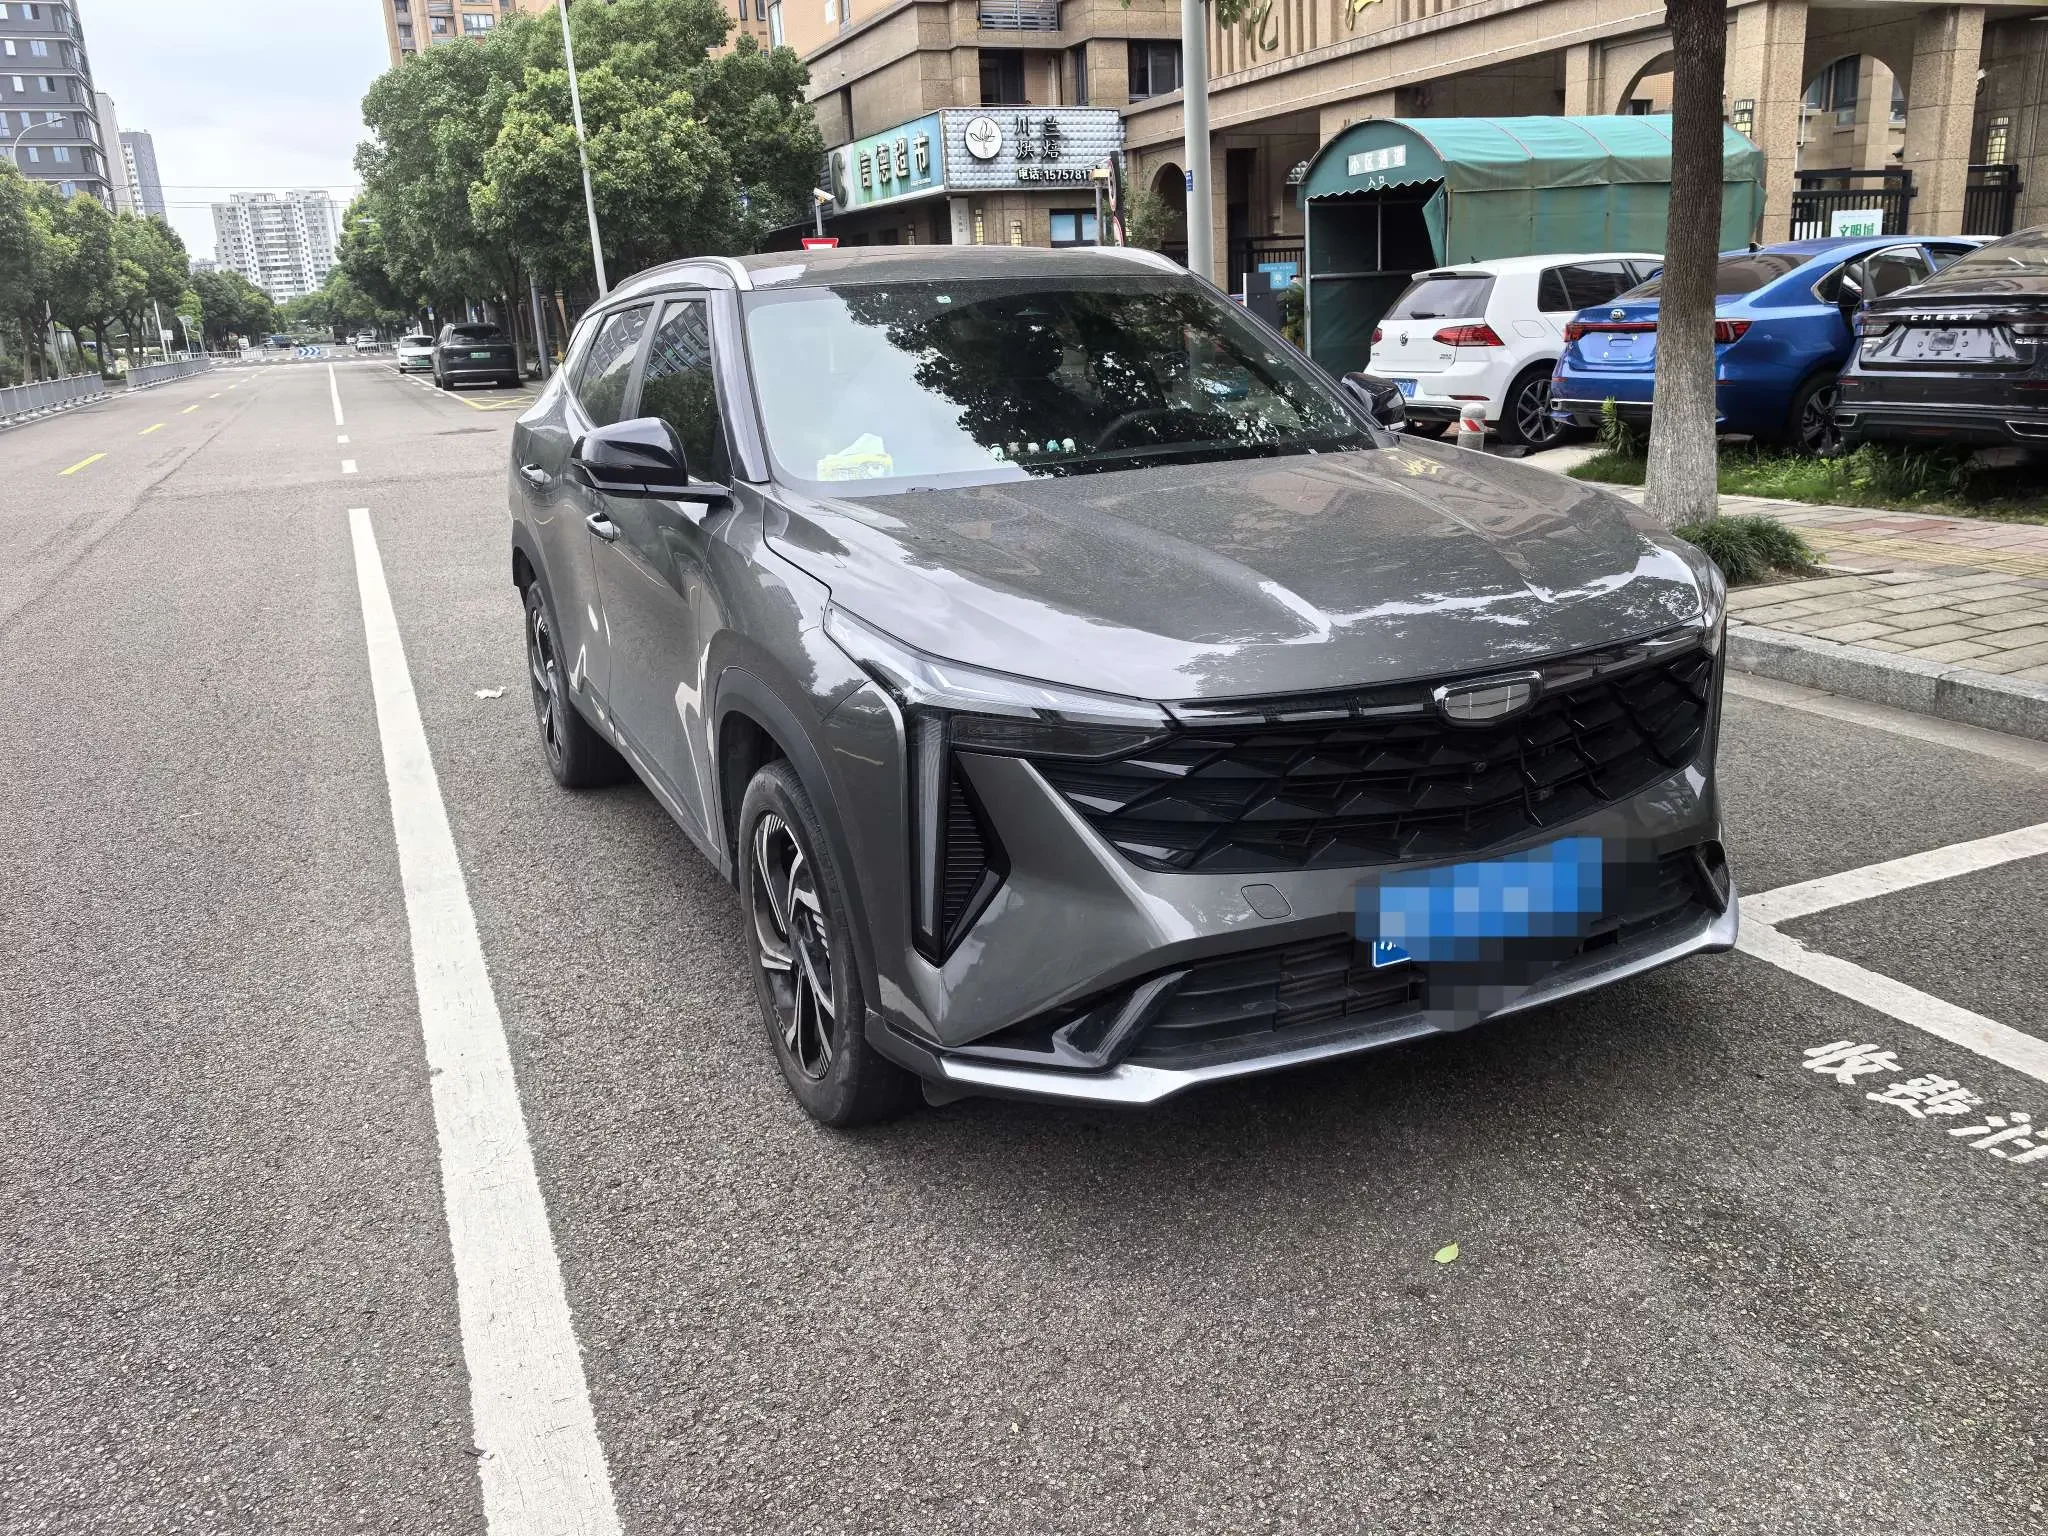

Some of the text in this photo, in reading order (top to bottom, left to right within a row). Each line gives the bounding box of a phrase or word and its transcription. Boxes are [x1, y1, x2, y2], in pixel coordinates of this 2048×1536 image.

[1015, 115, 1061, 136] 川兰
[1016, 139, 1060, 159] 烘焙
[1368, 175, 1385, 187] 入口
